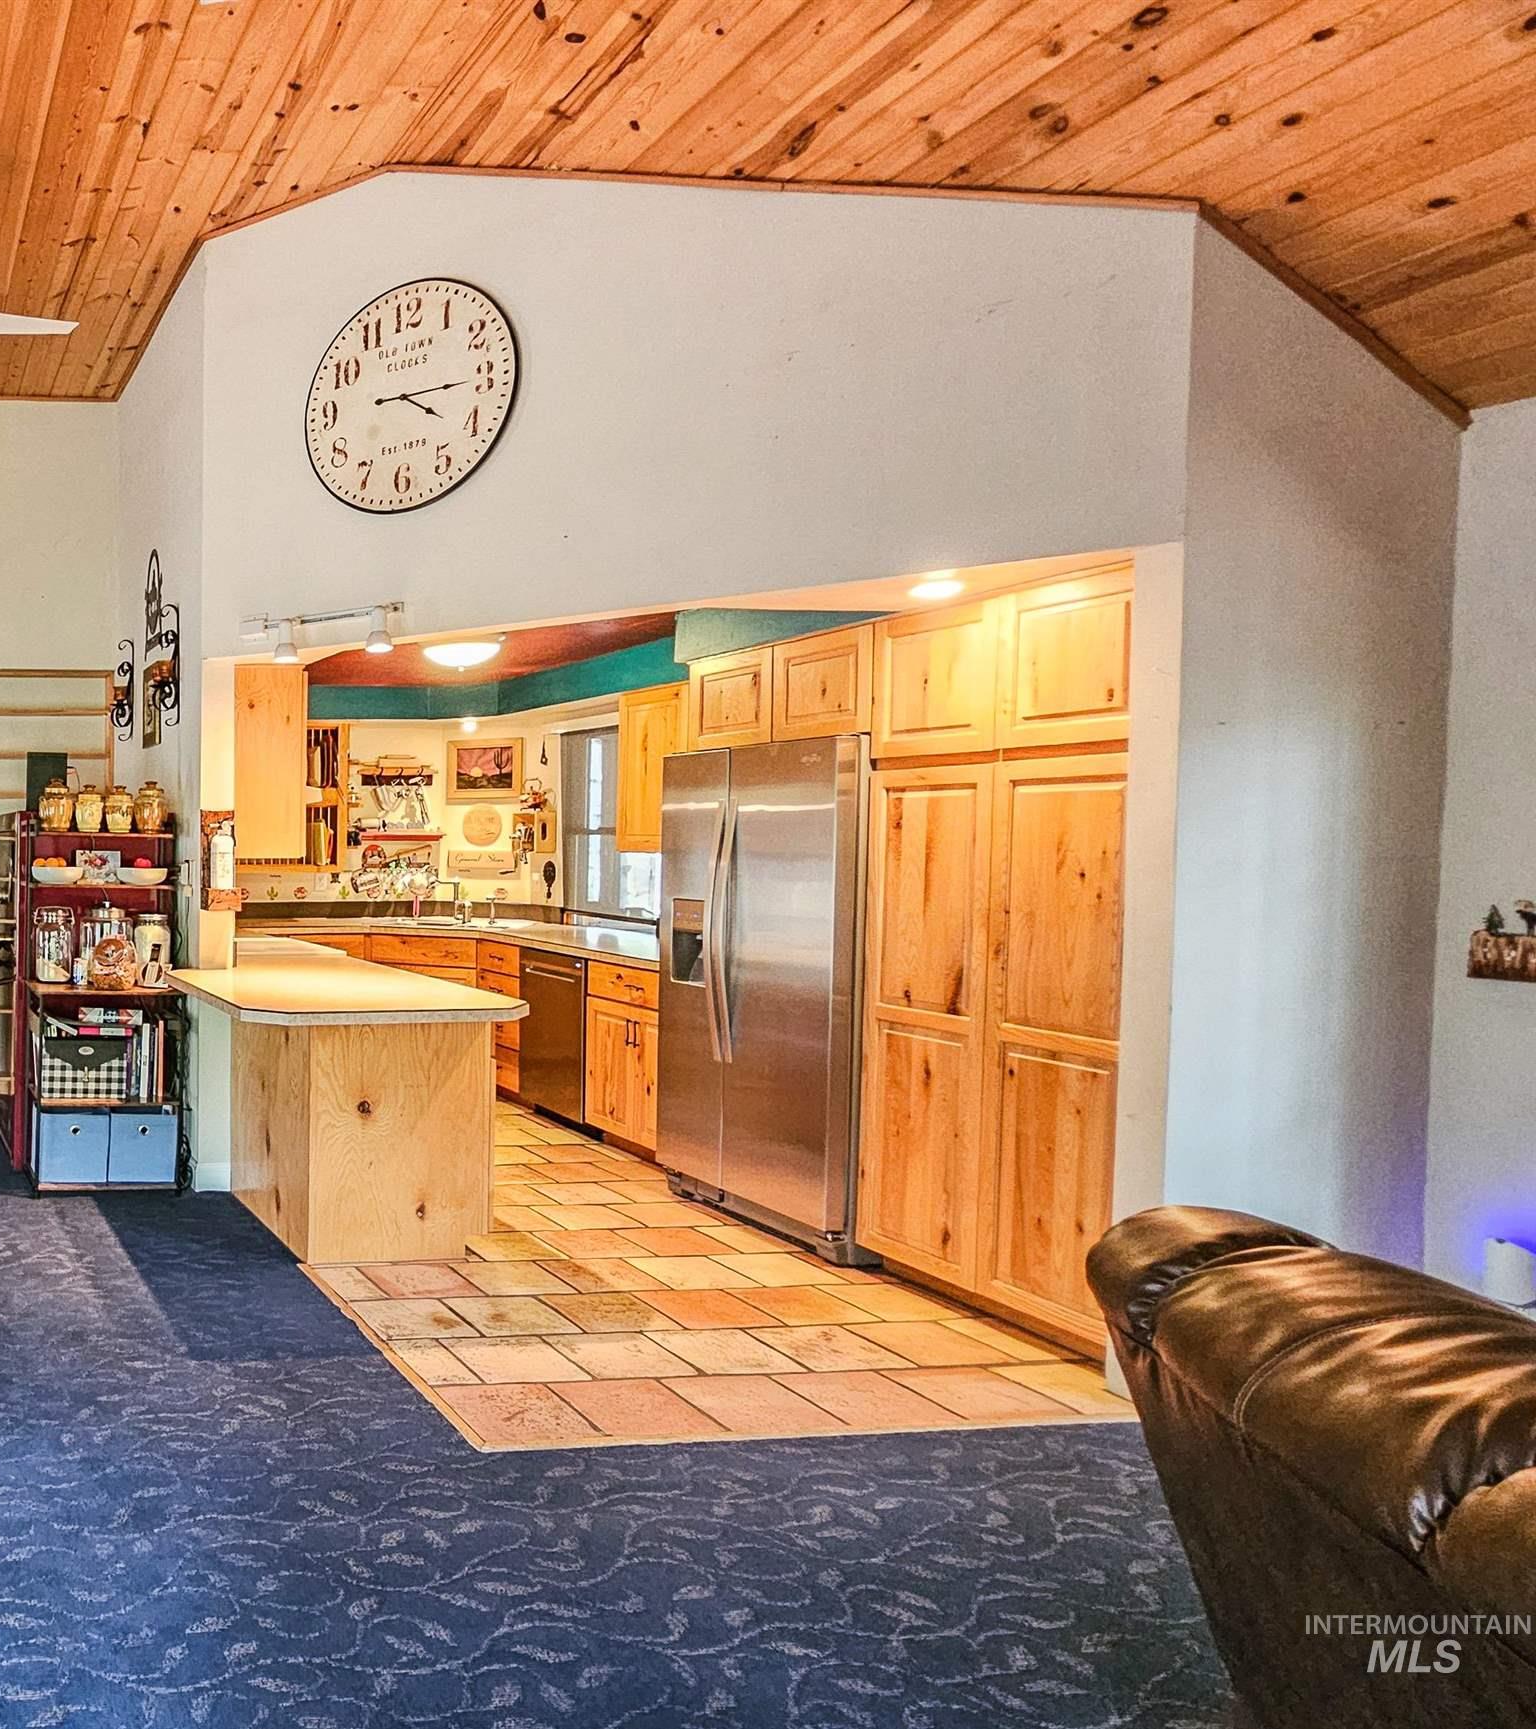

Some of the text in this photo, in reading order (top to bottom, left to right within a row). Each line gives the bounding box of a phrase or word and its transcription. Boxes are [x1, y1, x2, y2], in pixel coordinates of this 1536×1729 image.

[392, 297, 424, 335] 12
[439, 298, 452, 331] 1
[361, 318, 383, 352] 11
[468, 319, 487, 351] 2
[332, 356, 361, 390] 10
[387, 353, 428, 373] CLOCKS
[474, 360, 495, 394] 3
[322, 400, 338, 431] 9
[463, 404, 479, 438] 4
[330, 437, 348, 469] 8
[434, 442, 452, 476] 5
[357, 459, 374, 491] 7
[393, 462, 411, 495] 6
